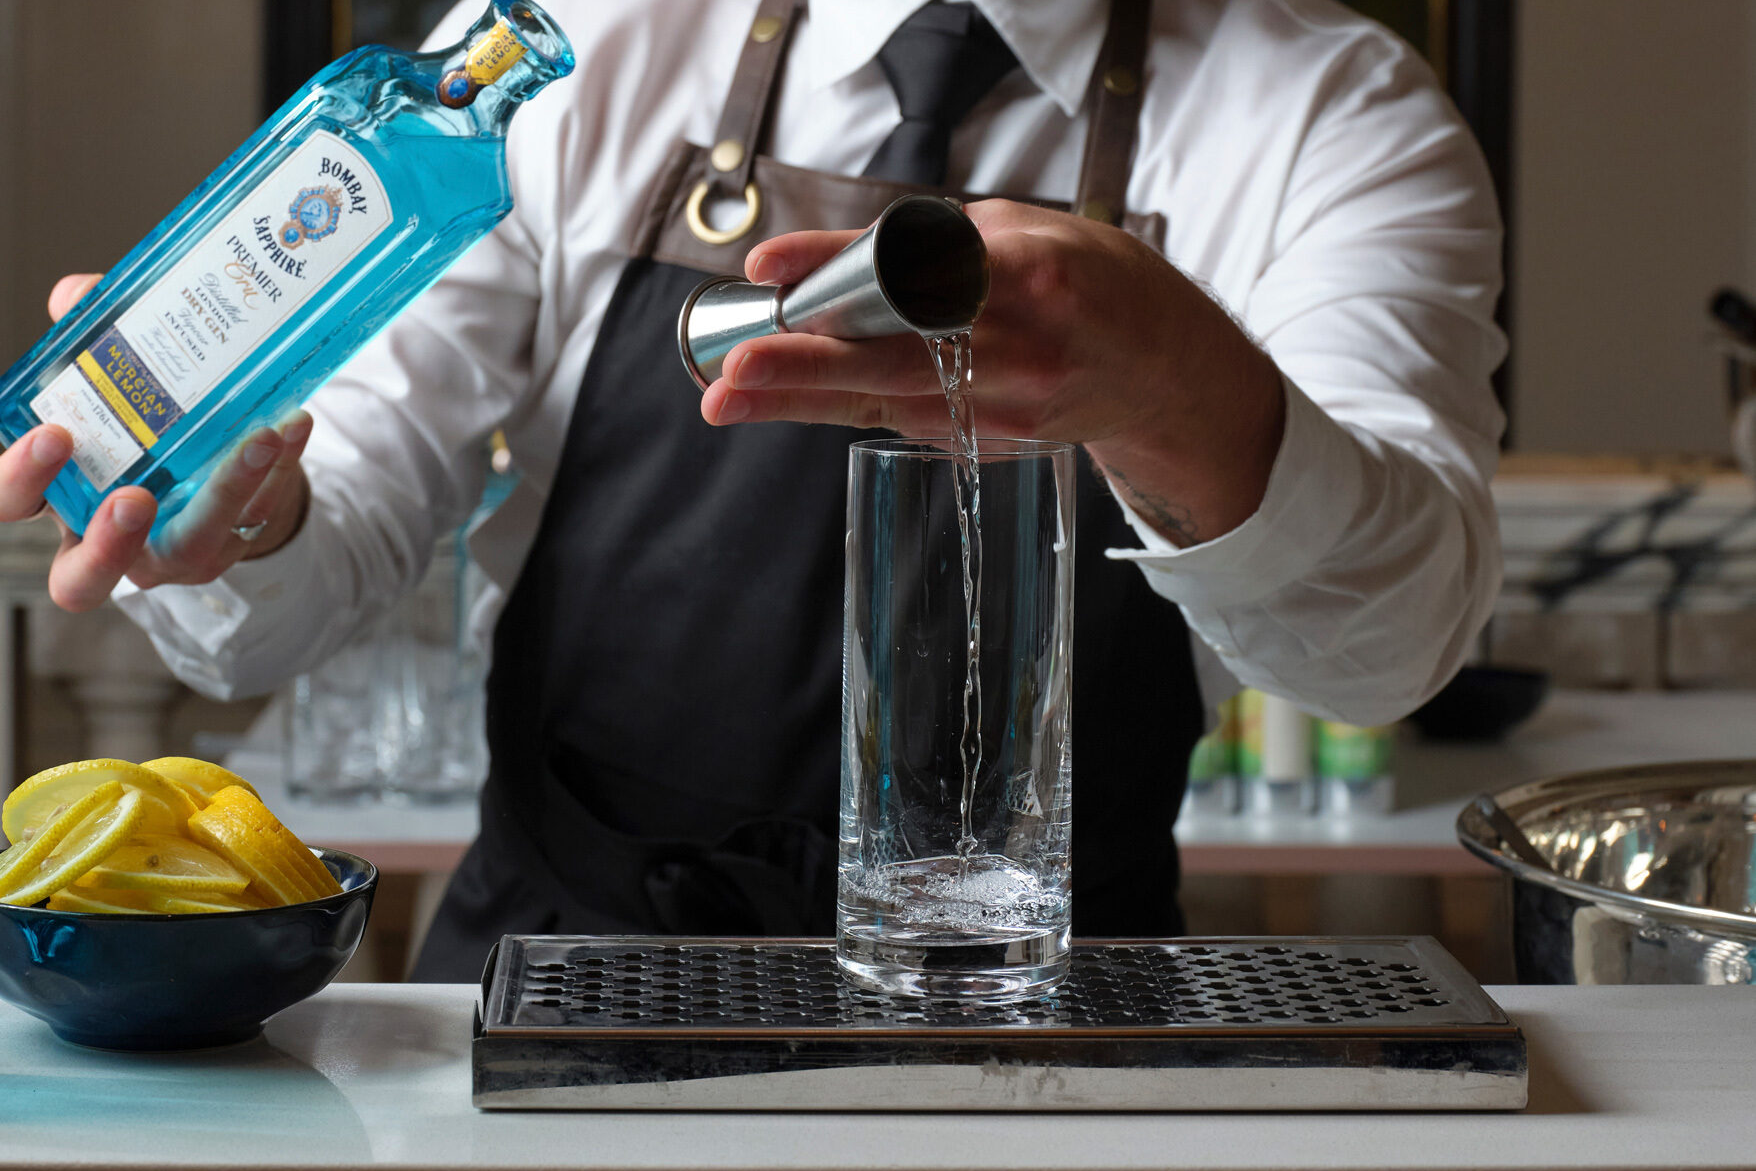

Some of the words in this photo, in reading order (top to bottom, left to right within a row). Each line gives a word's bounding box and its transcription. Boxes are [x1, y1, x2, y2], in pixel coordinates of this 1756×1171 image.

[476, 30, 515, 67] MURCIAN
[486, 40, 517, 69] LEMON
[318, 157, 367, 215] BOMBAY
[227, 235, 282, 303] PREMIER
[254, 215, 307, 279] SAPPHIRE
[195, 287, 230, 330] LONDON
[198, 272, 248, 325] Distilled
[224, 258, 259, 310] Cru
[164, 311, 205, 361] INFUSED
[181, 287, 203, 317] DRY
[205, 317, 229, 345] GIN
[106, 361, 152, 416] LEMON
[108, 345, 166, 417] MURCIAN
[93, 404, 111, 427] 1761
